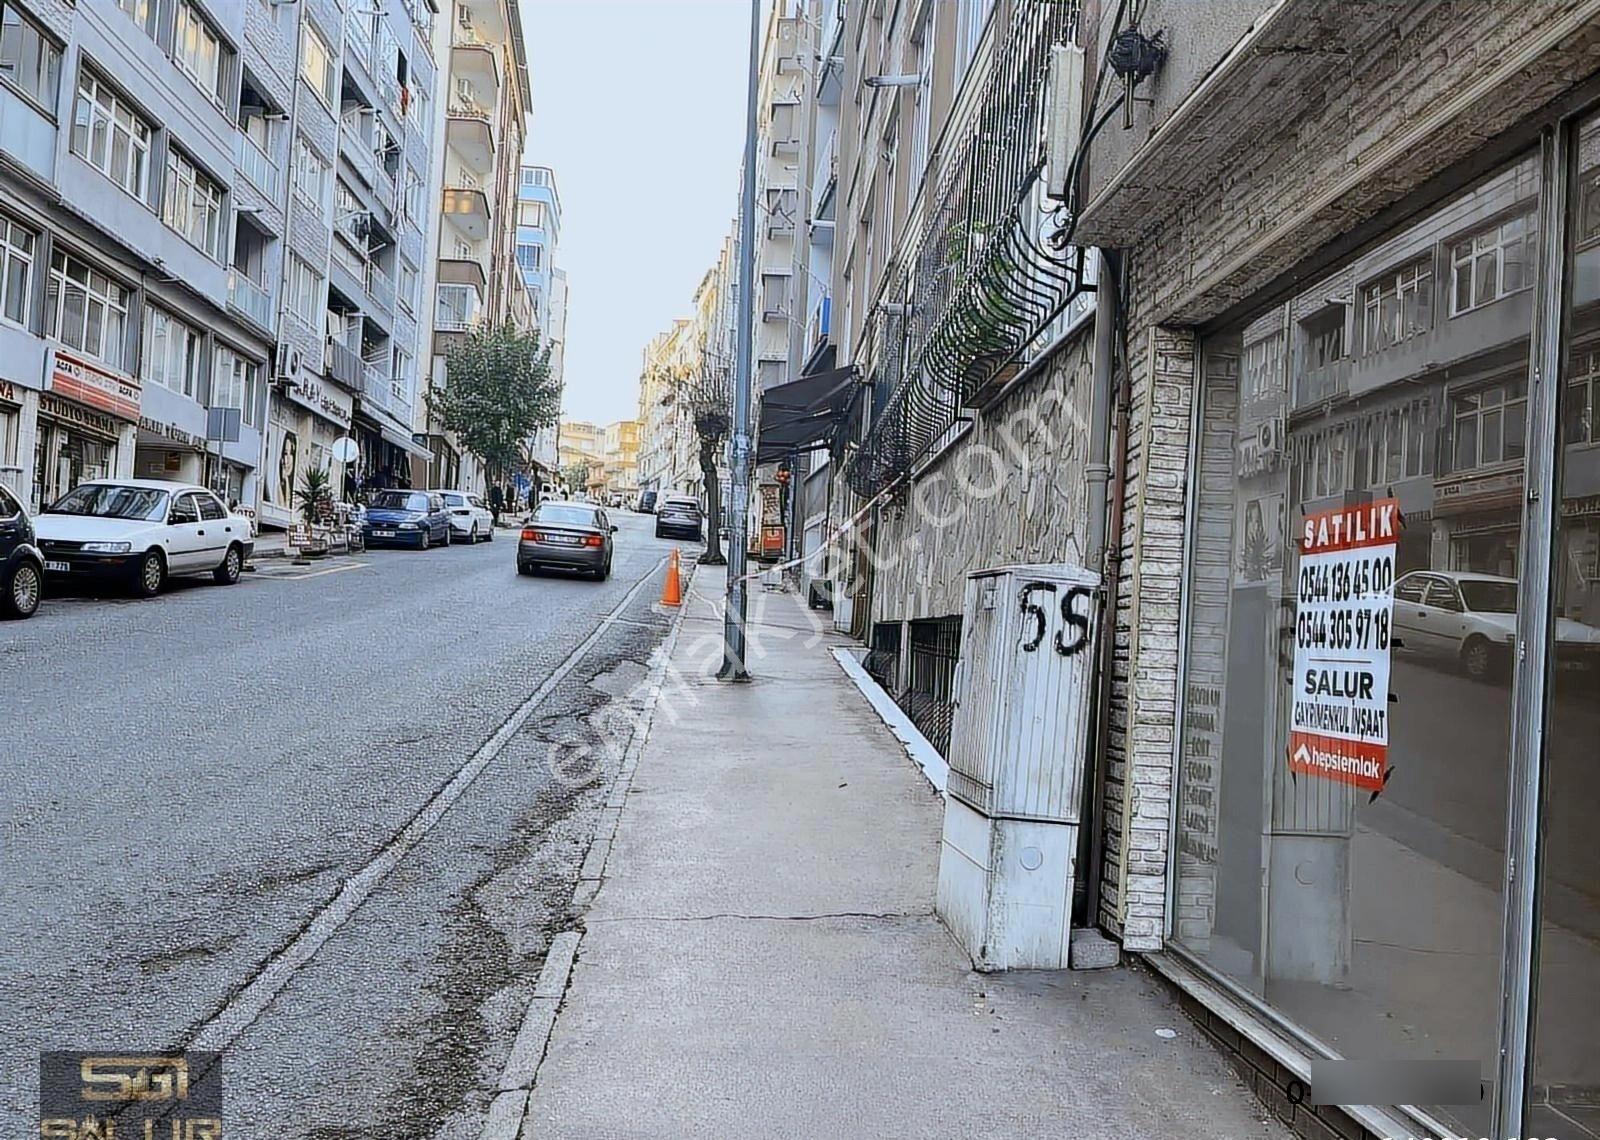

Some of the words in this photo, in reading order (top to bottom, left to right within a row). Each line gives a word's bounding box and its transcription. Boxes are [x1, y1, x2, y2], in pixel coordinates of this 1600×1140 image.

[1304, 504, 1393, 548] SATILIK
[1300, 564, 1328, 603] 0544
[1330, 561, 1350, 602] 136
[1353, 559, 1370, 600] 45
[1372, 556, 1391, 600] 00
[1298, 610, 1326, 648] 0544
[1329, 609, 1352, 649] 305
[1355, 608, 1371, 650] 97
[1374, 607, 1388, 650] 18
[1304, 669, 1374, 700] SALUR
[1312, 746, 1380, 779] hepsiemlak
